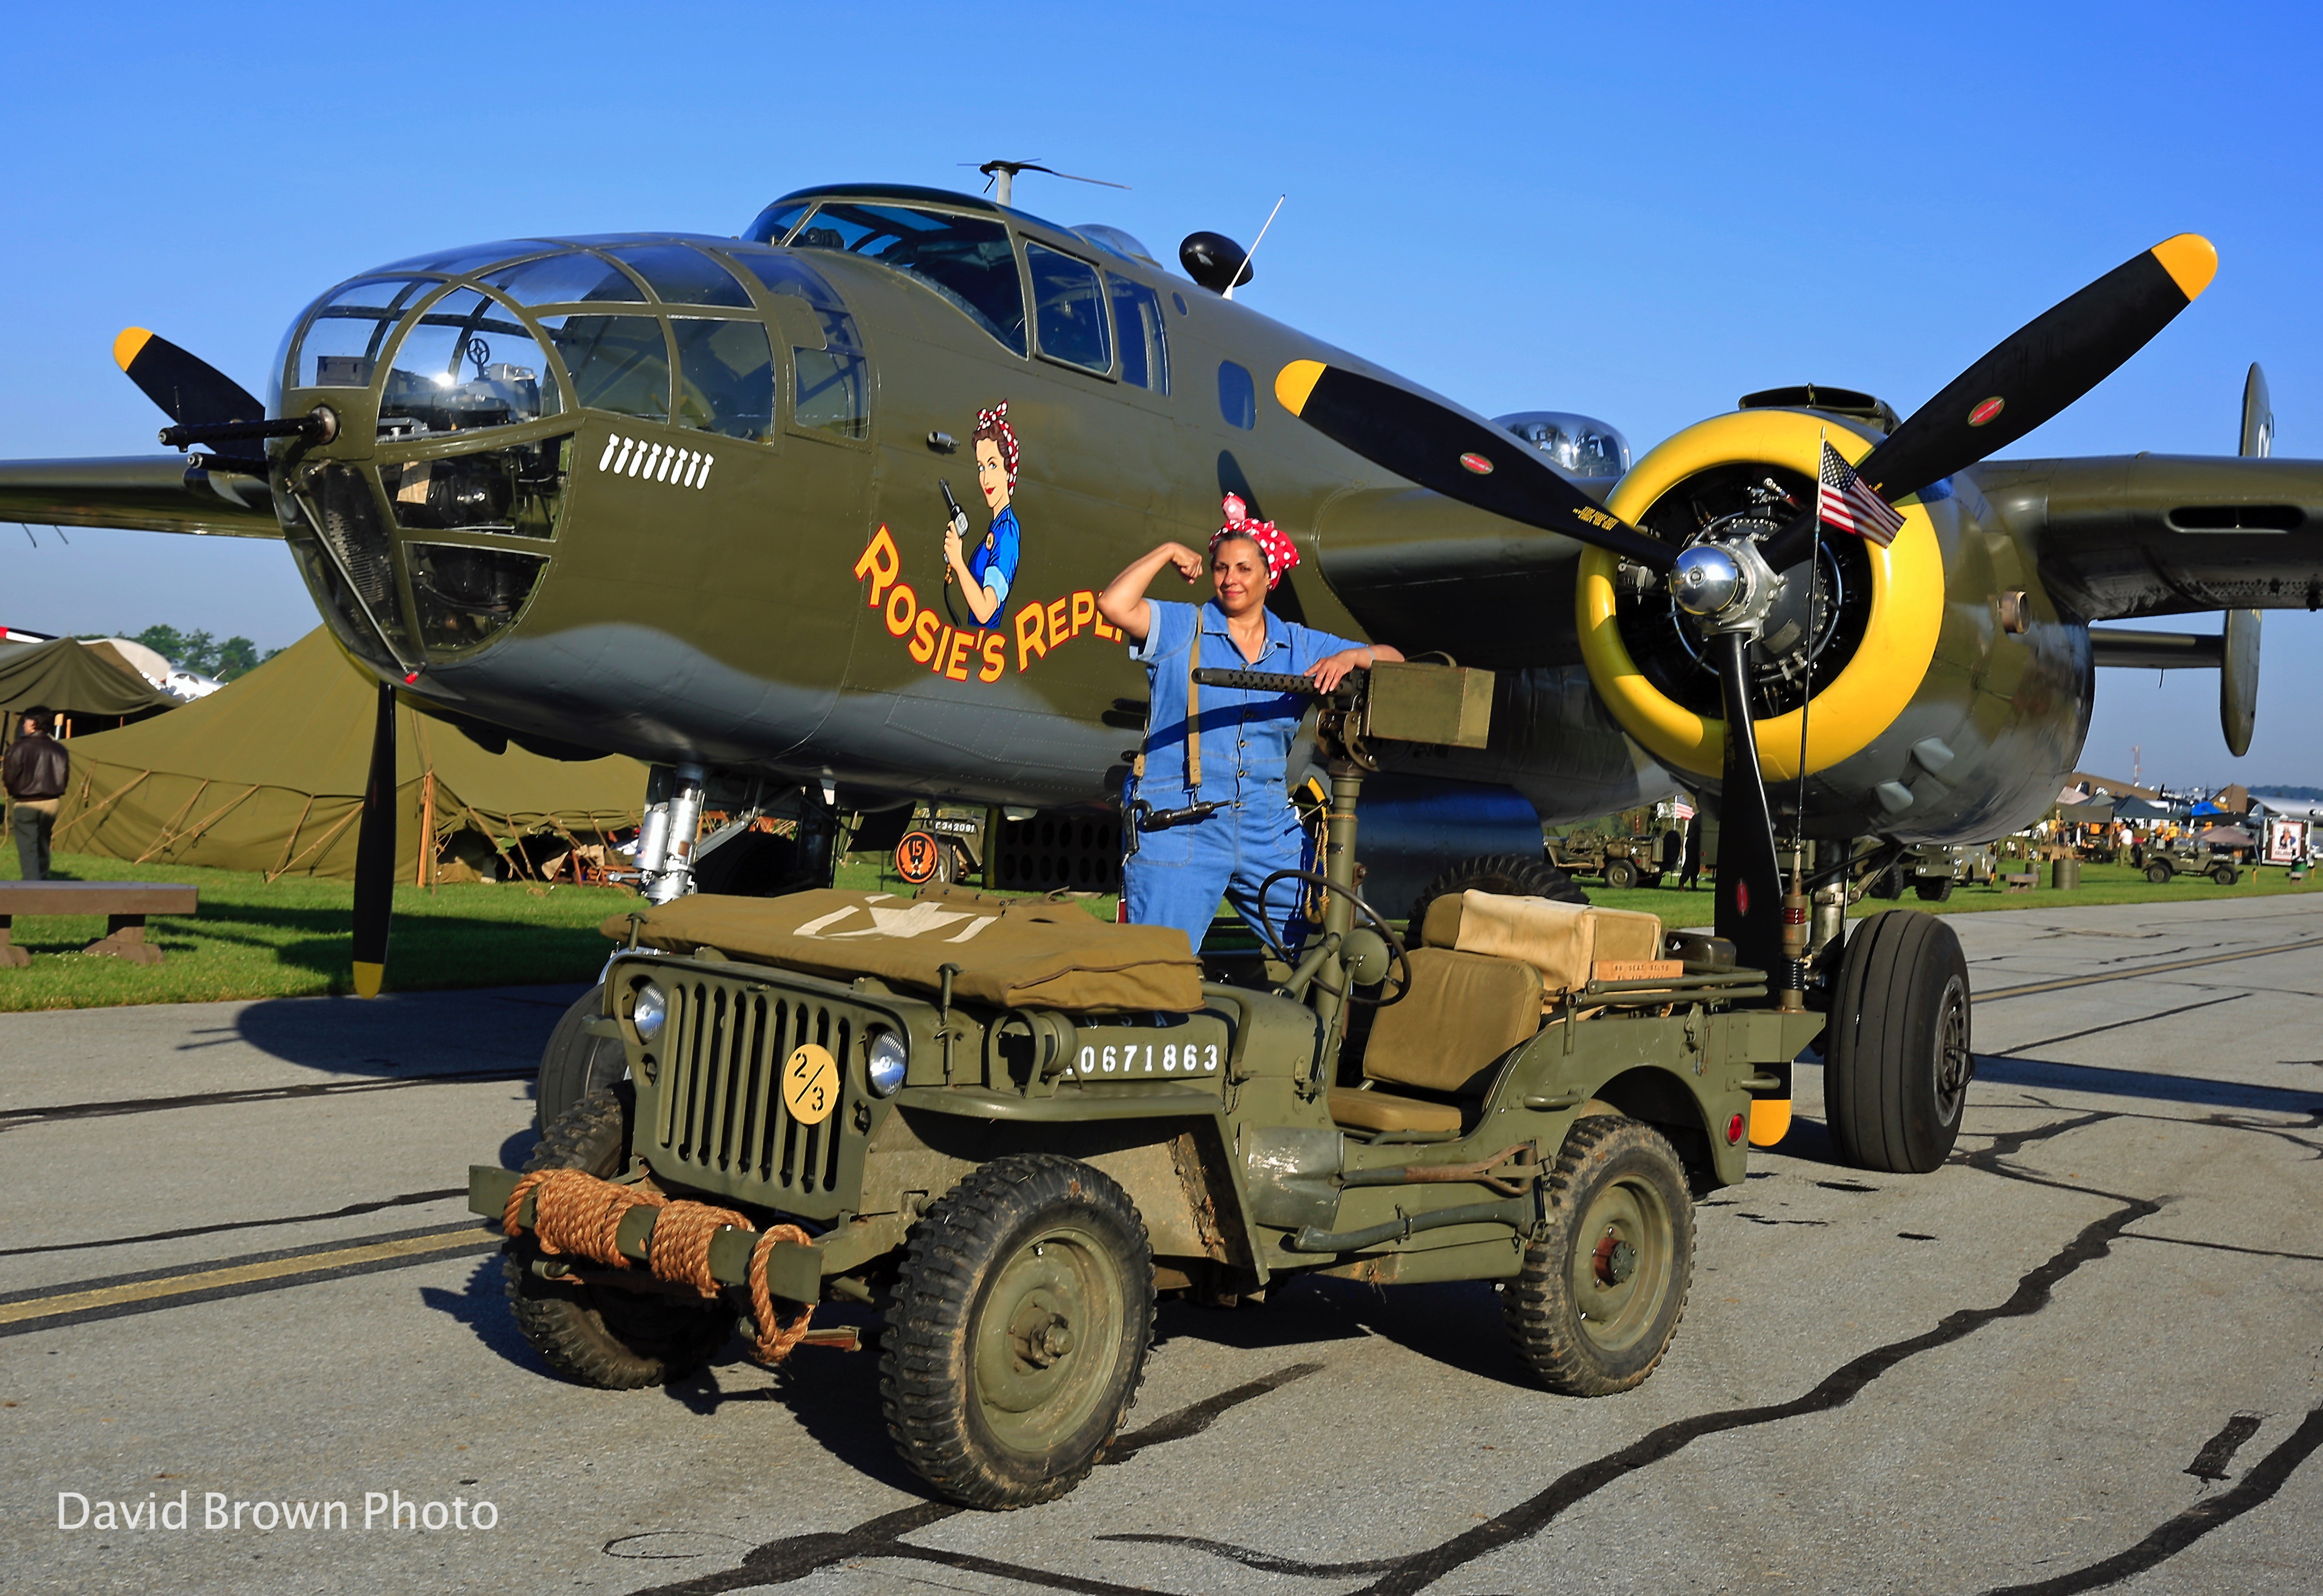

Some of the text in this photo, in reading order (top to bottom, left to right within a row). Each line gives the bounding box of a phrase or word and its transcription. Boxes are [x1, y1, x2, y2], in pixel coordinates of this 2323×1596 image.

[853, 523, 1007, 683] ROSIE'S
[912, 840, 922, 856] 15
[1065, 1044, 1218, 1075] 0671863
